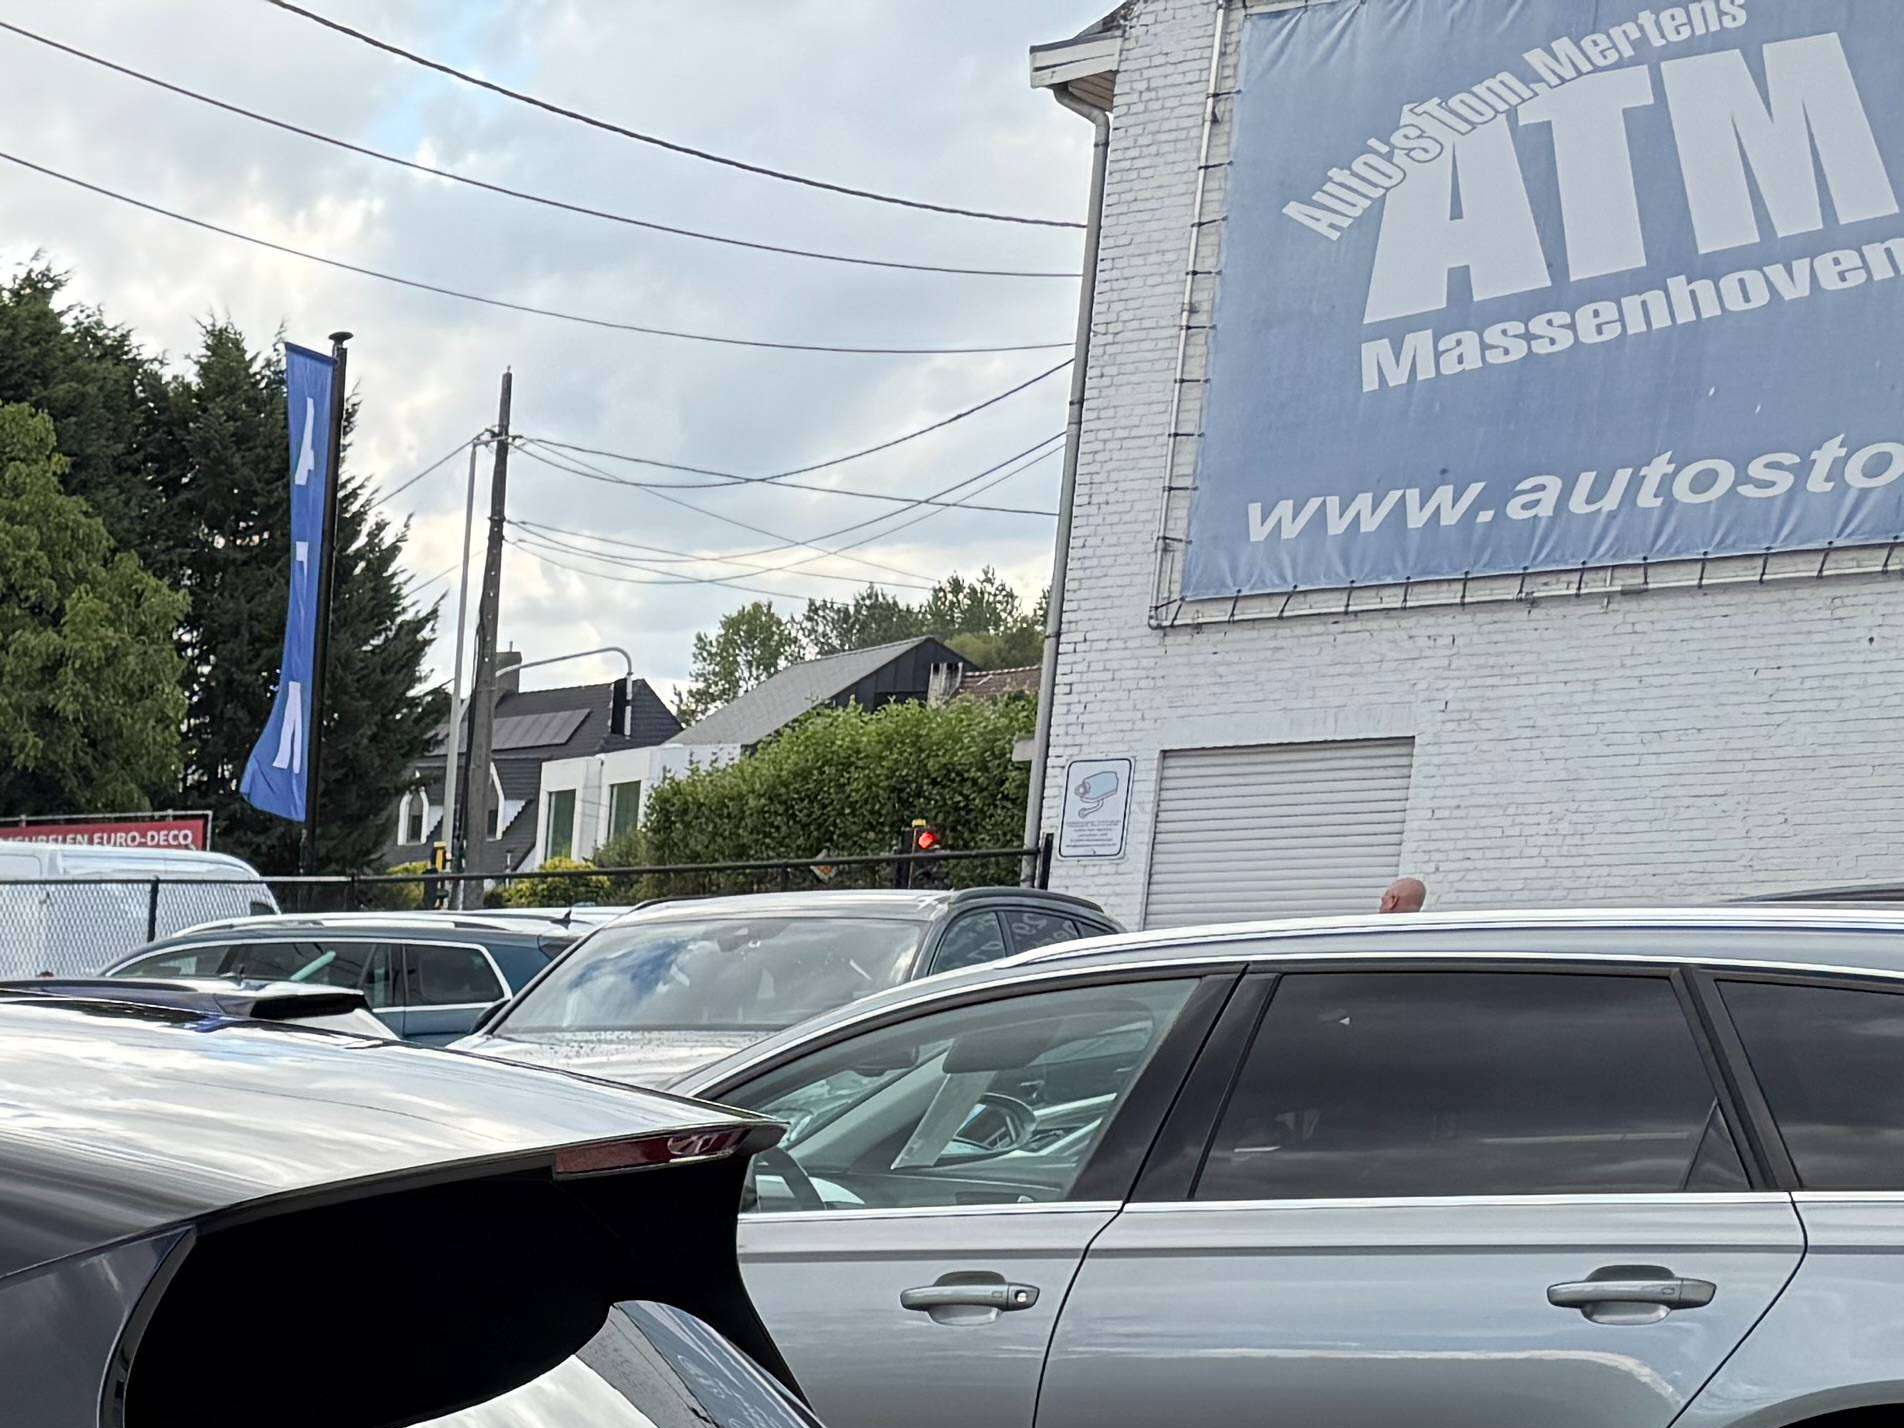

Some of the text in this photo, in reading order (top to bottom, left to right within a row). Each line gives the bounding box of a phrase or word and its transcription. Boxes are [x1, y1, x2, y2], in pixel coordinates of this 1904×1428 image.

[1282, 0, 1749, 241] Auto's Tom Mertens
[1363, 32, 1900, 325] ATM
[1360, 238, 1904, 393] Massenhoven
[1247, 434, 1904, 541] www.autosto
